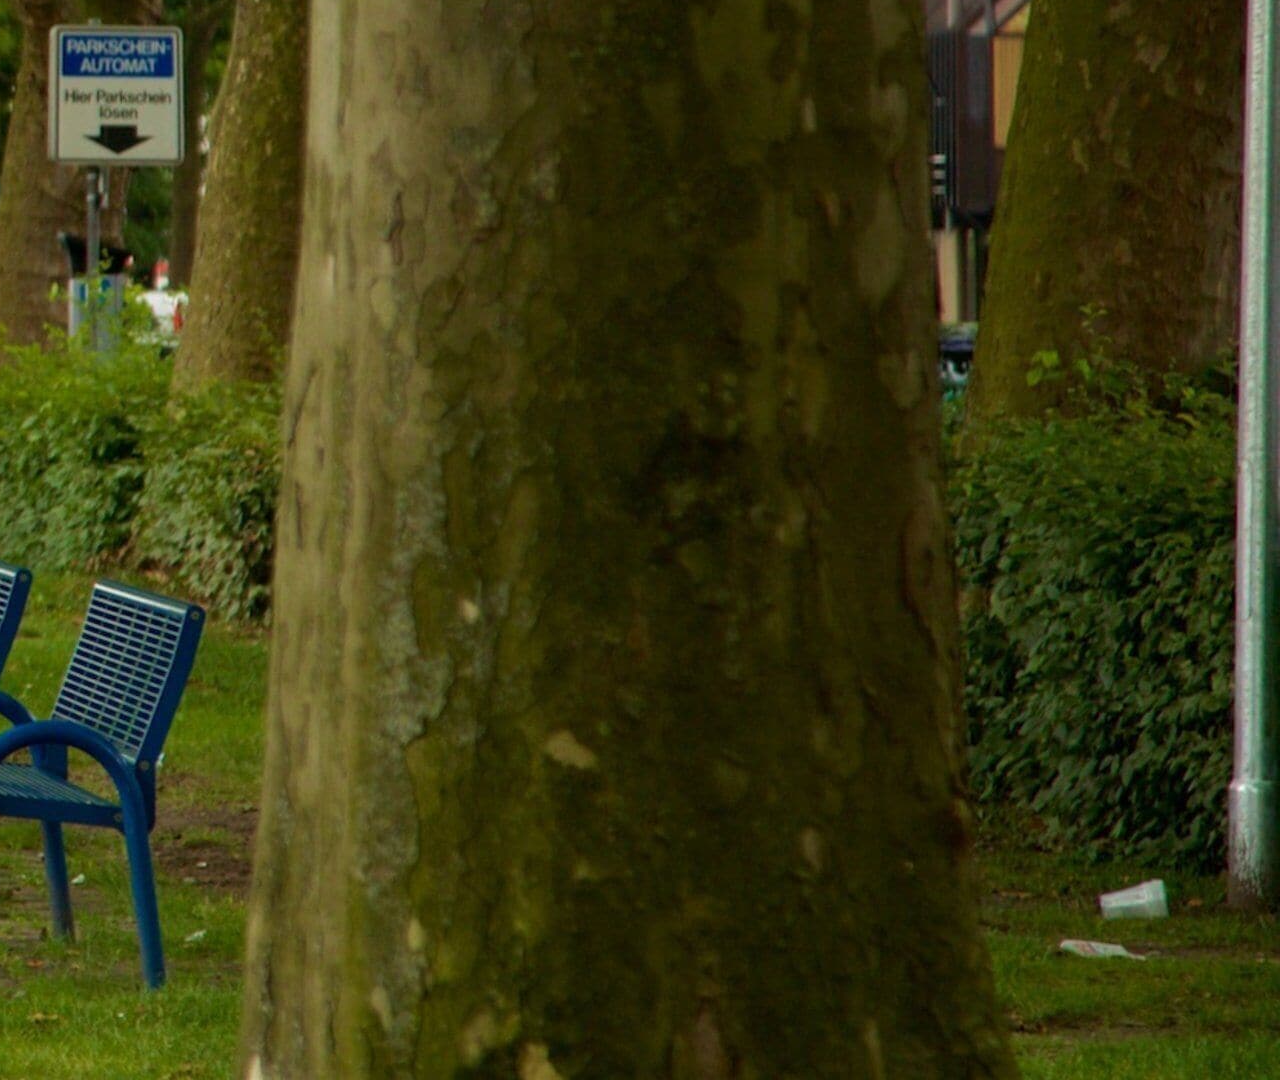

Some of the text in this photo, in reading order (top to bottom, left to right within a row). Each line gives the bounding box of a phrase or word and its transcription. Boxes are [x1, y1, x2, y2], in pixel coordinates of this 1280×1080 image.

[80, 57, 157, 73] AUTOMAT
[64, 88, 172, 104] Hier Parkschein
[99, 106, 139, 120] lösen
